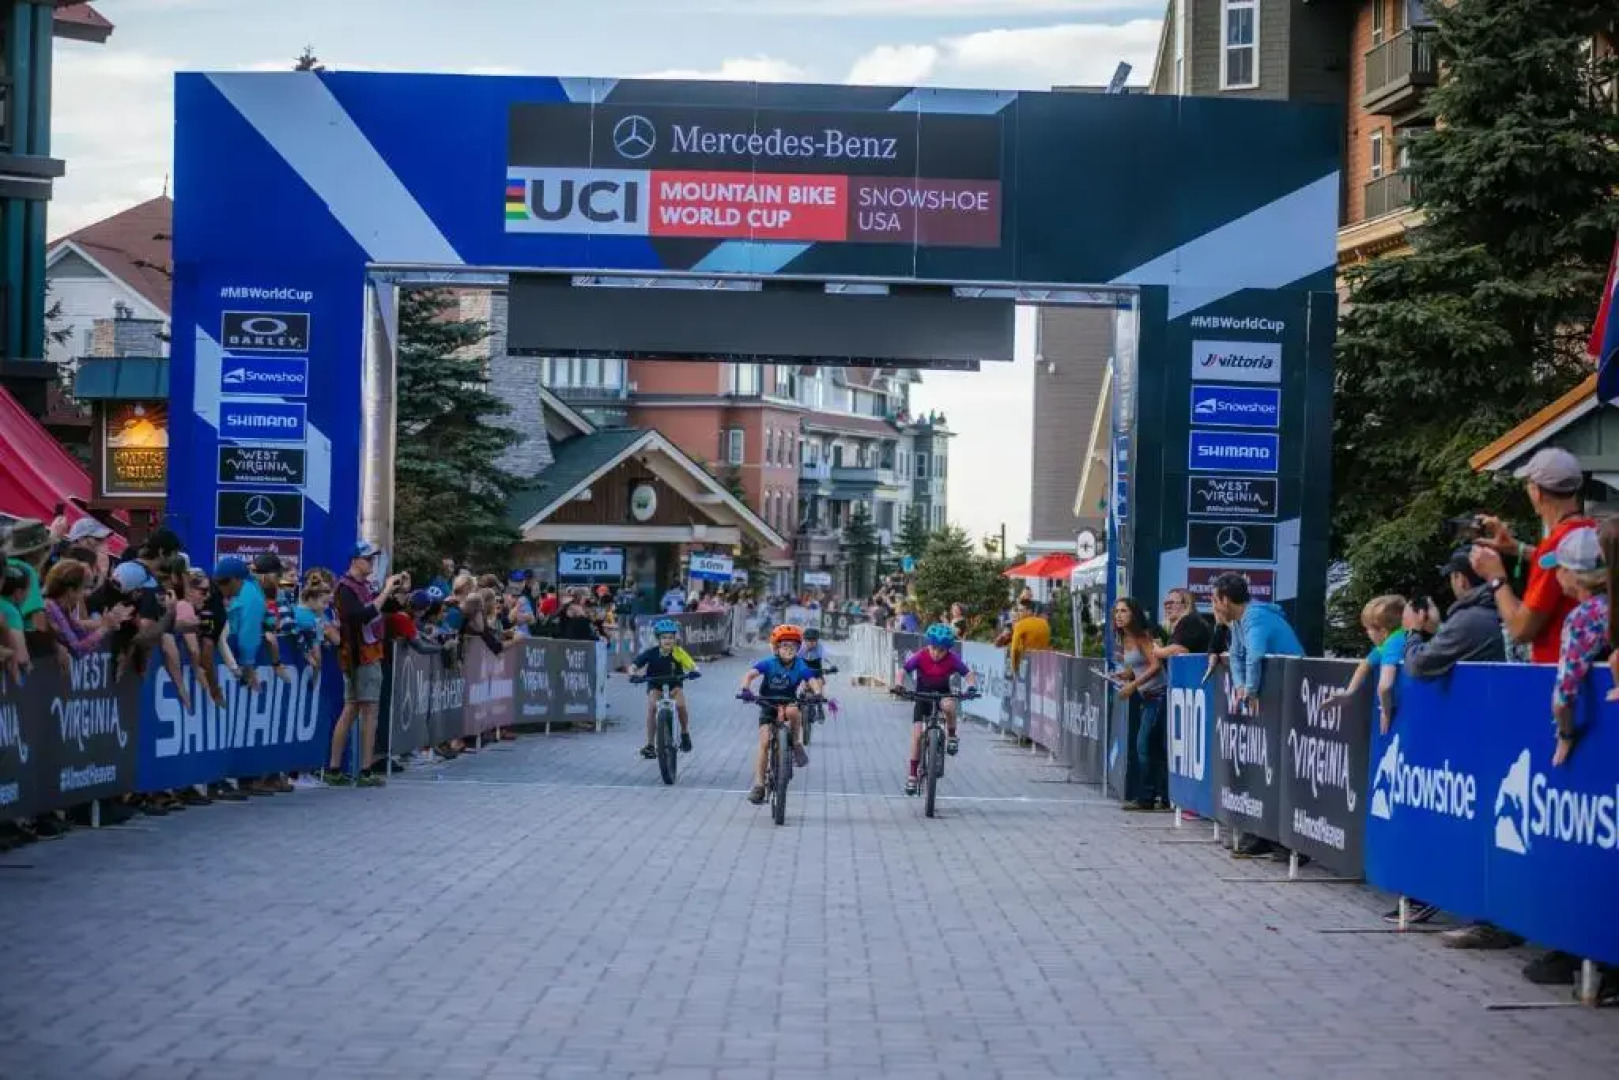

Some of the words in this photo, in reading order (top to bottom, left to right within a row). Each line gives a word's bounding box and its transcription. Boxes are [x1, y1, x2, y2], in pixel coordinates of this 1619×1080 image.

[671, 125, 897, 159] Mercedes-Benz
[526, 179, 638, 223] UCI
[660, 182, 785, 204] MOUNTAIN
[788, 186, 835, 205] BIKE
[858, 188, 989, 210] SNOWSHOE
[660, 206, 740, 227] WORLD
[748, 208, 791, 228] CUP
[858, 211, 901, 232] USA
[220, 287, 313, 301] #MBWorldCup
[1191, 316, 1285, 333] #MBWorldCup
[229, 336, 300, 346] OAKLEY
[1219, 354, 1273, 370] vittoria
[246, 370, 304, 382] Snowshoe
[1217, 401, 1276, 413] Snowshoe
[227, 415, 298, 428] SHIMANO
[237, 450, 279, 461] WEST
[1197, 445, 1270, 459] SHIMANO
[226, 459, 297, 475] VIRGINIA
[1208, 480, 1252, 491] WEST
[1197, 489, 1269, 506] VIRGINIA
[573, 557, 608, 570] 25m
[69, 652, 112, 691] WEST
[50, 696, 128, 751] VIRGINIA
[1216, 716, 1273, 786] VIRGINIA
[1288, 729, 1356, 812] VIRGINIA
[1394, 752, 1476, 819] Snowshoe
